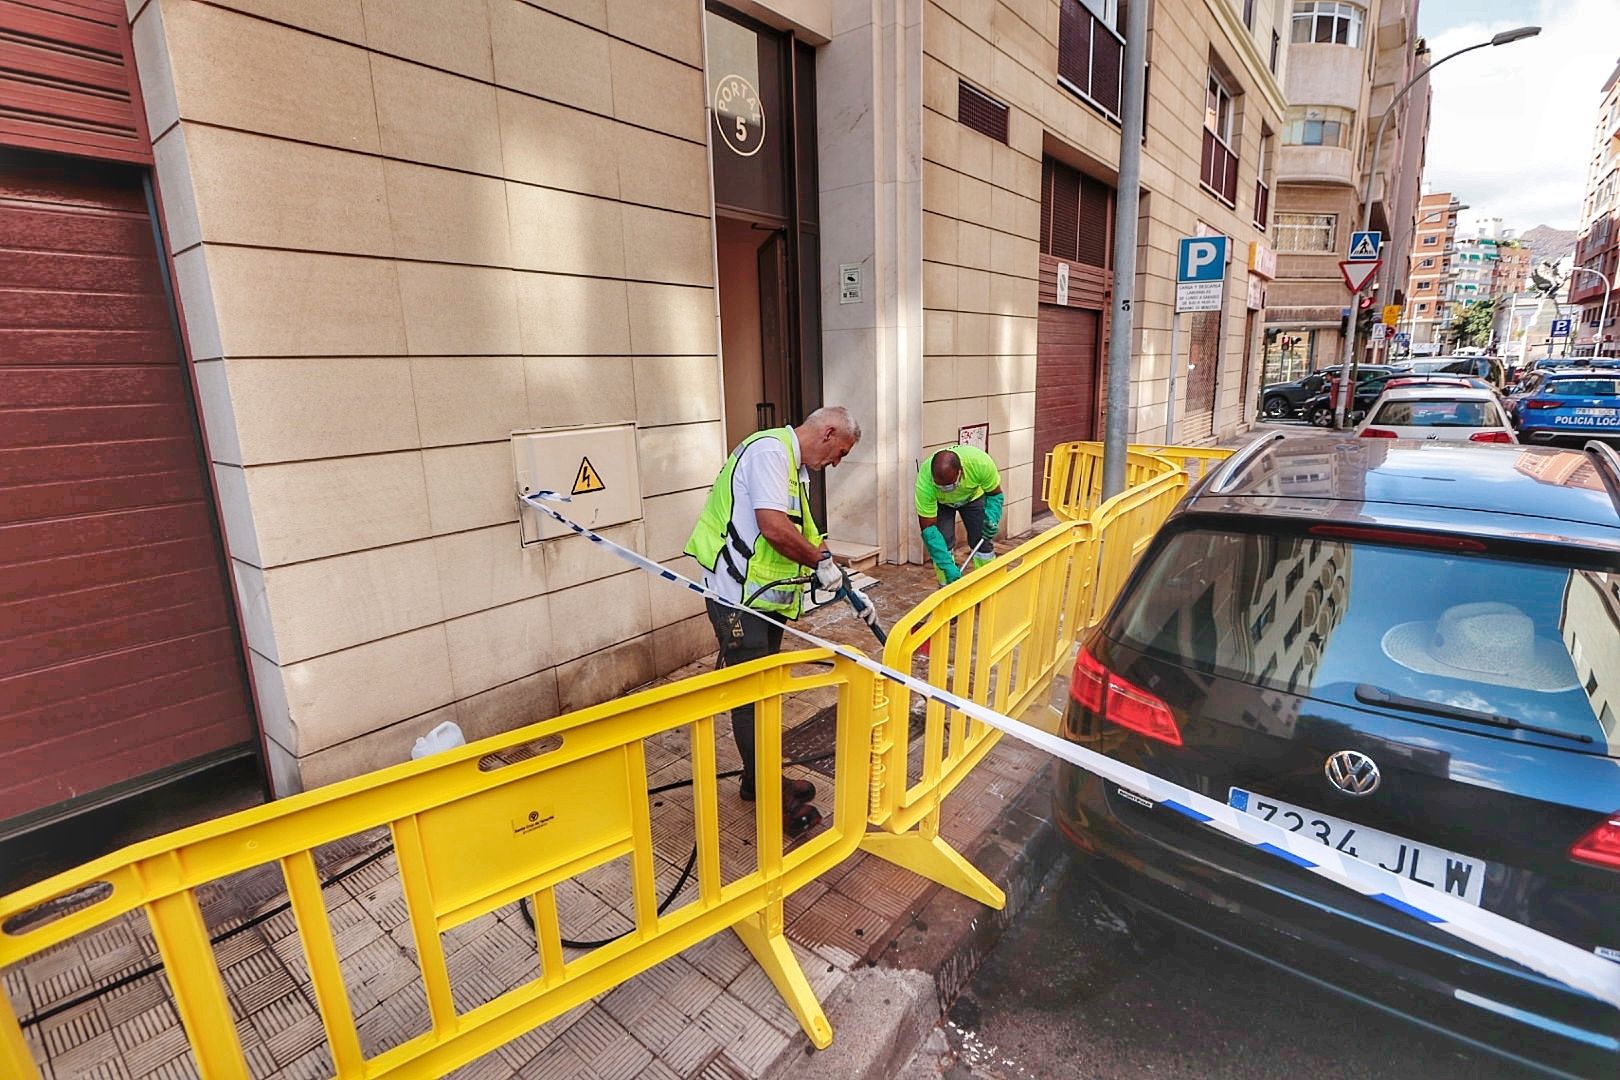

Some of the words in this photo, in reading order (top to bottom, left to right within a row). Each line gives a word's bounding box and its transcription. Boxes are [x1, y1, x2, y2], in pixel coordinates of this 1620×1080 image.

[718, 81, 762, 123] PORTAL
[735, 116, 748, 142] 5
[1187, 242, 1217, 278] P
[1554, 415, 1595, 425] POLICIA
[1378, 843, 1473, 898] JLW
